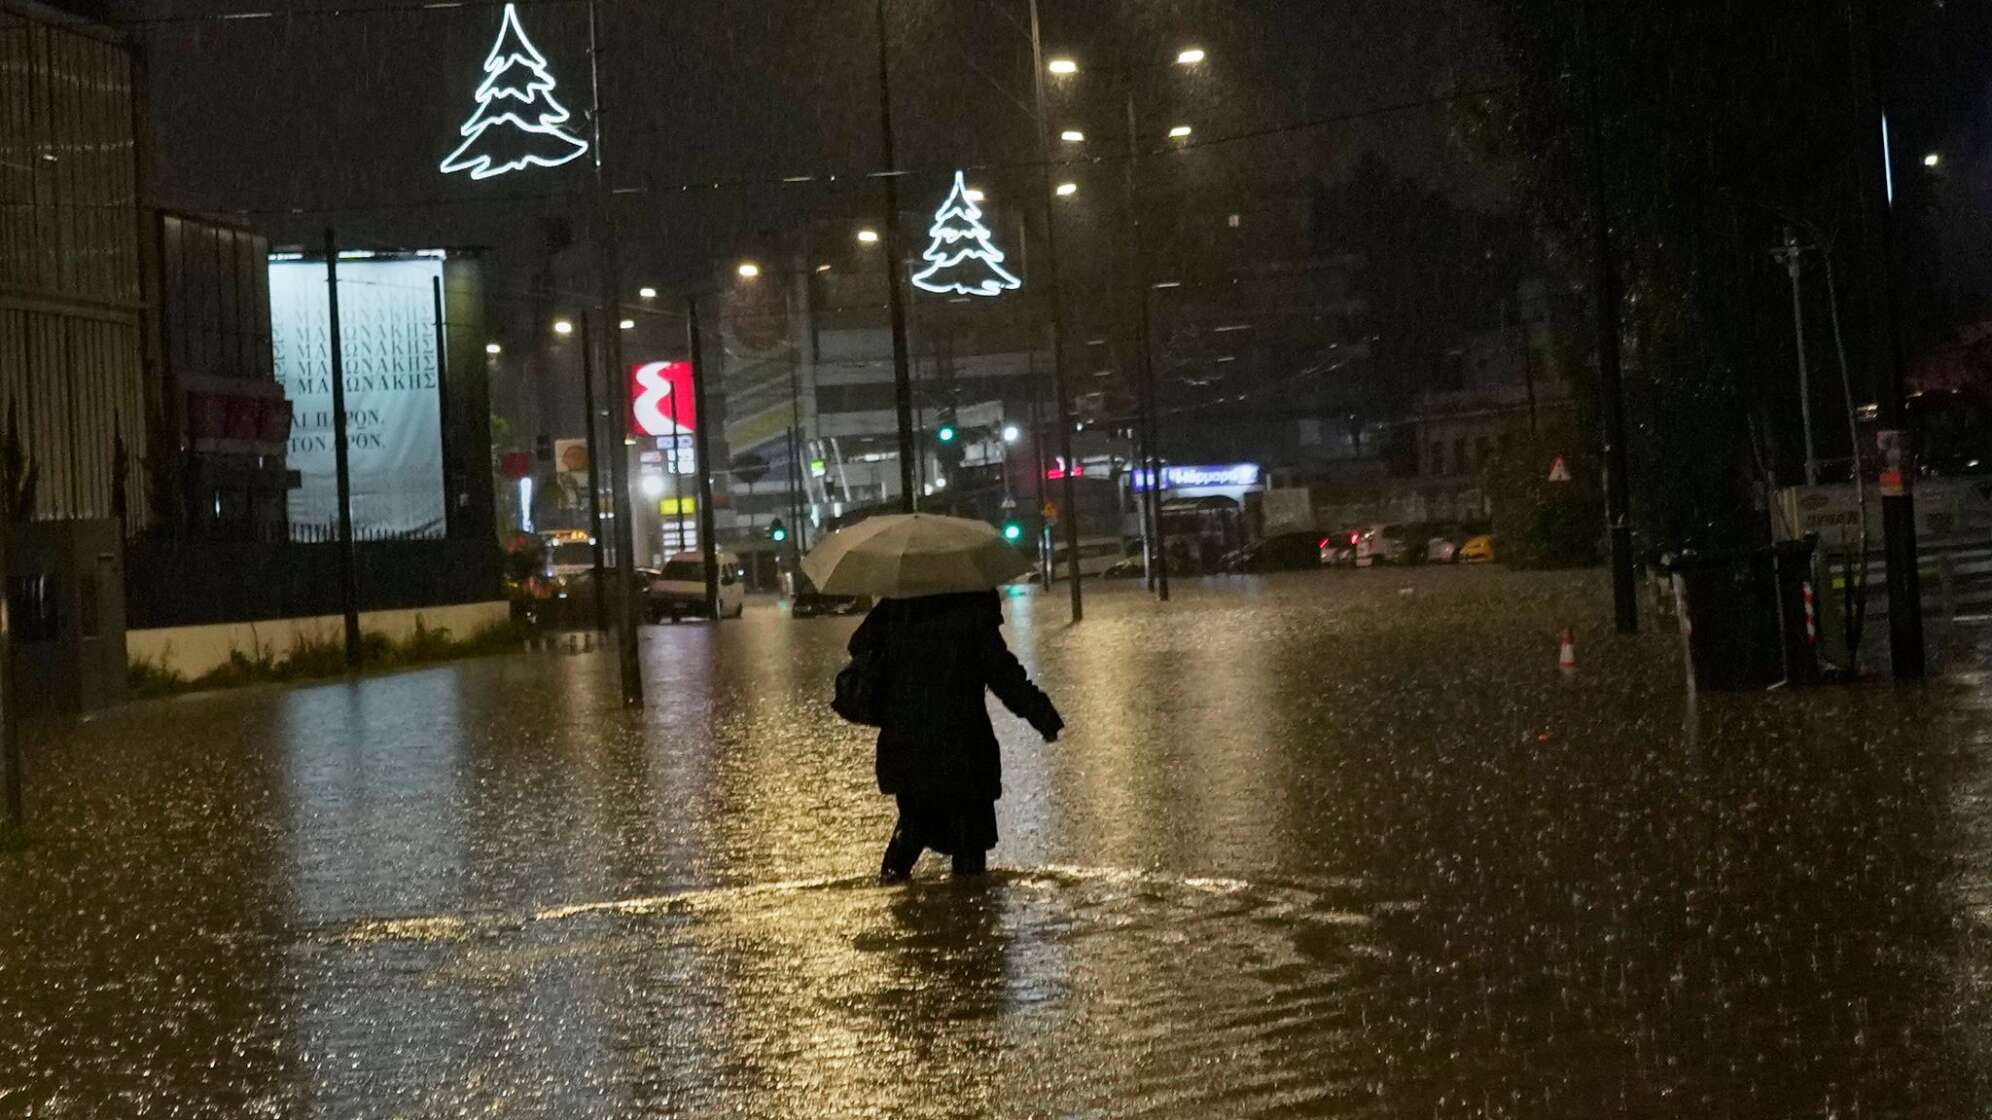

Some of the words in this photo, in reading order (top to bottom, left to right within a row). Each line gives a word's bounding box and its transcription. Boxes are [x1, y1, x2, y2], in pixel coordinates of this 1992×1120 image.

[297, 322, 434, 342] ΜΑΩΝΑΚΗΣ
[297, 339, 435, 359] ΜΑΩΝΑΚΗΣ
[297, 356, 436, 376] ΜΑΩΝΑΚΗΣ
[297, 373, 436, 394] ΜΑΩΝΑΚΗΣ
